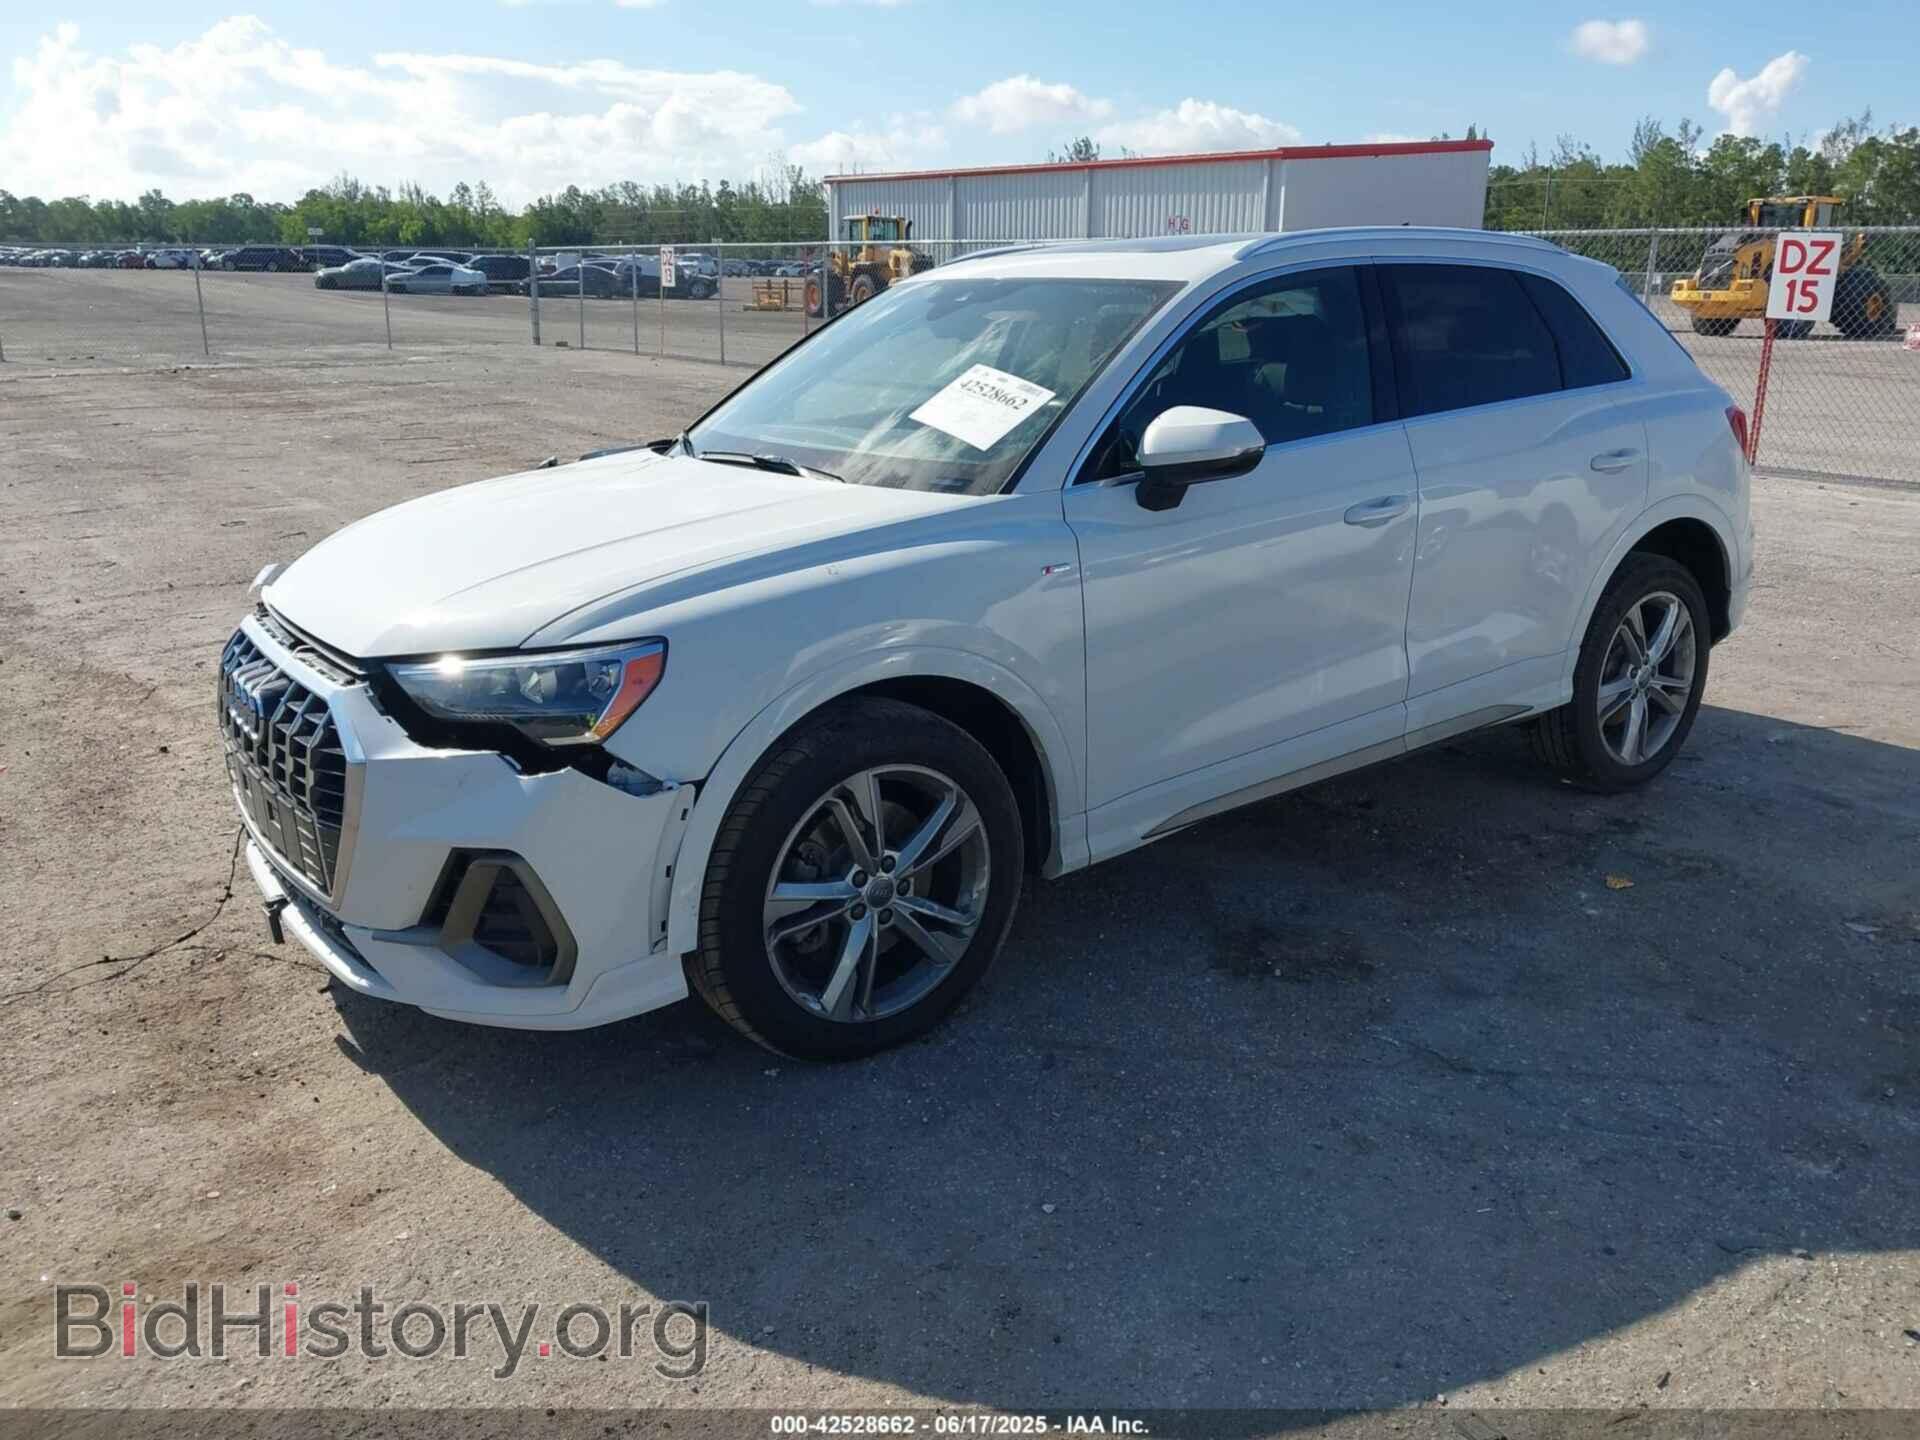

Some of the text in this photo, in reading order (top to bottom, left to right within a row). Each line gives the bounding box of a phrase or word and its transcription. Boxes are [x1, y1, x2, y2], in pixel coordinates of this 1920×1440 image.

[1779, 239, 1836, 275] DZ
[1786, 278, 1819, 313] 15
[960, 379, 1028, 410] 42528662
